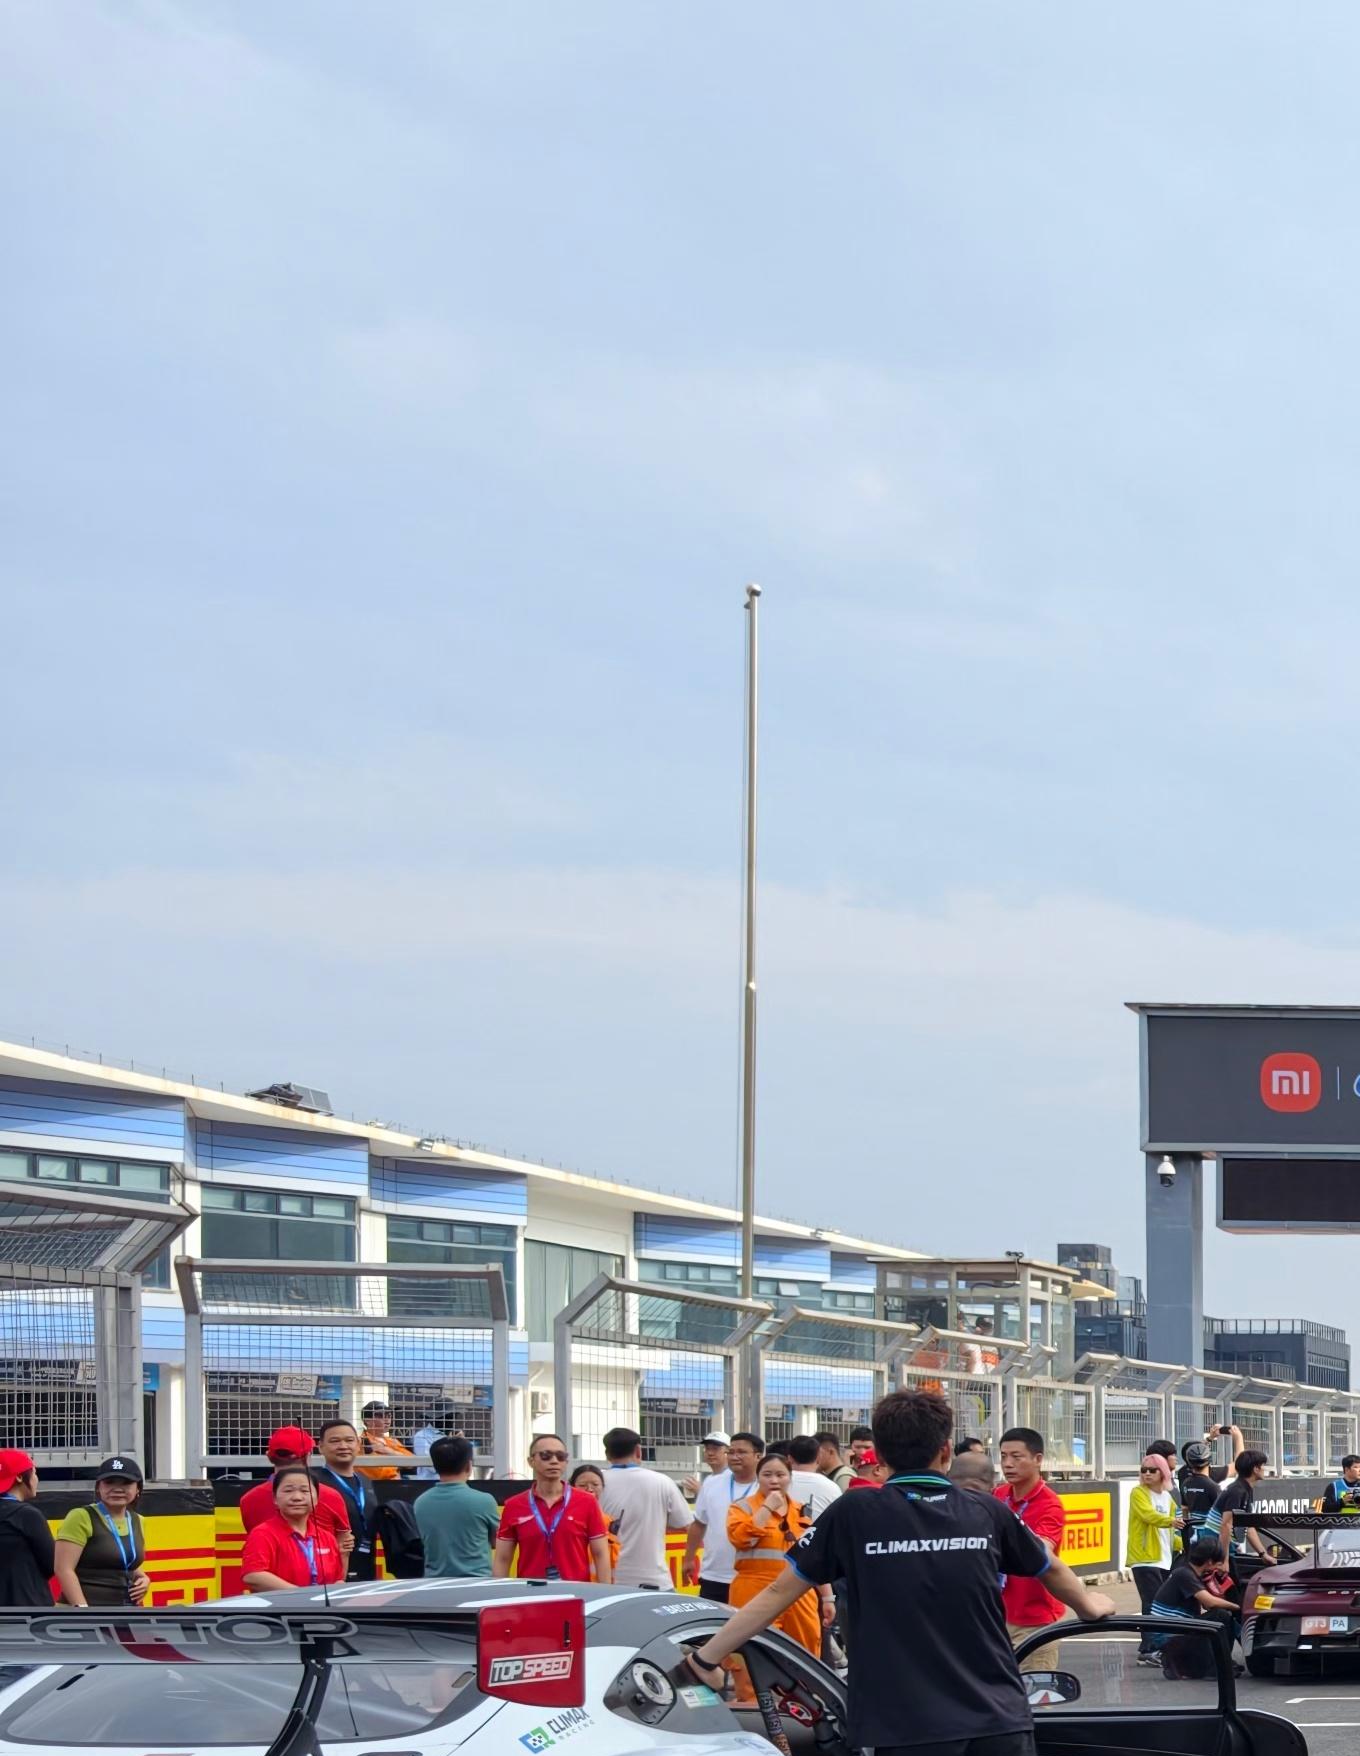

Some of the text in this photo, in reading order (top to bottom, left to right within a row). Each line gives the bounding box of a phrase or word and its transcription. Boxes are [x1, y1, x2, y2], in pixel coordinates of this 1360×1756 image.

[1332, 1619, 1346, 1628] PA
[492, 1656, 571, 1681] TOP SPEED
[547, 1706, 592, 1734] CLIMAX
